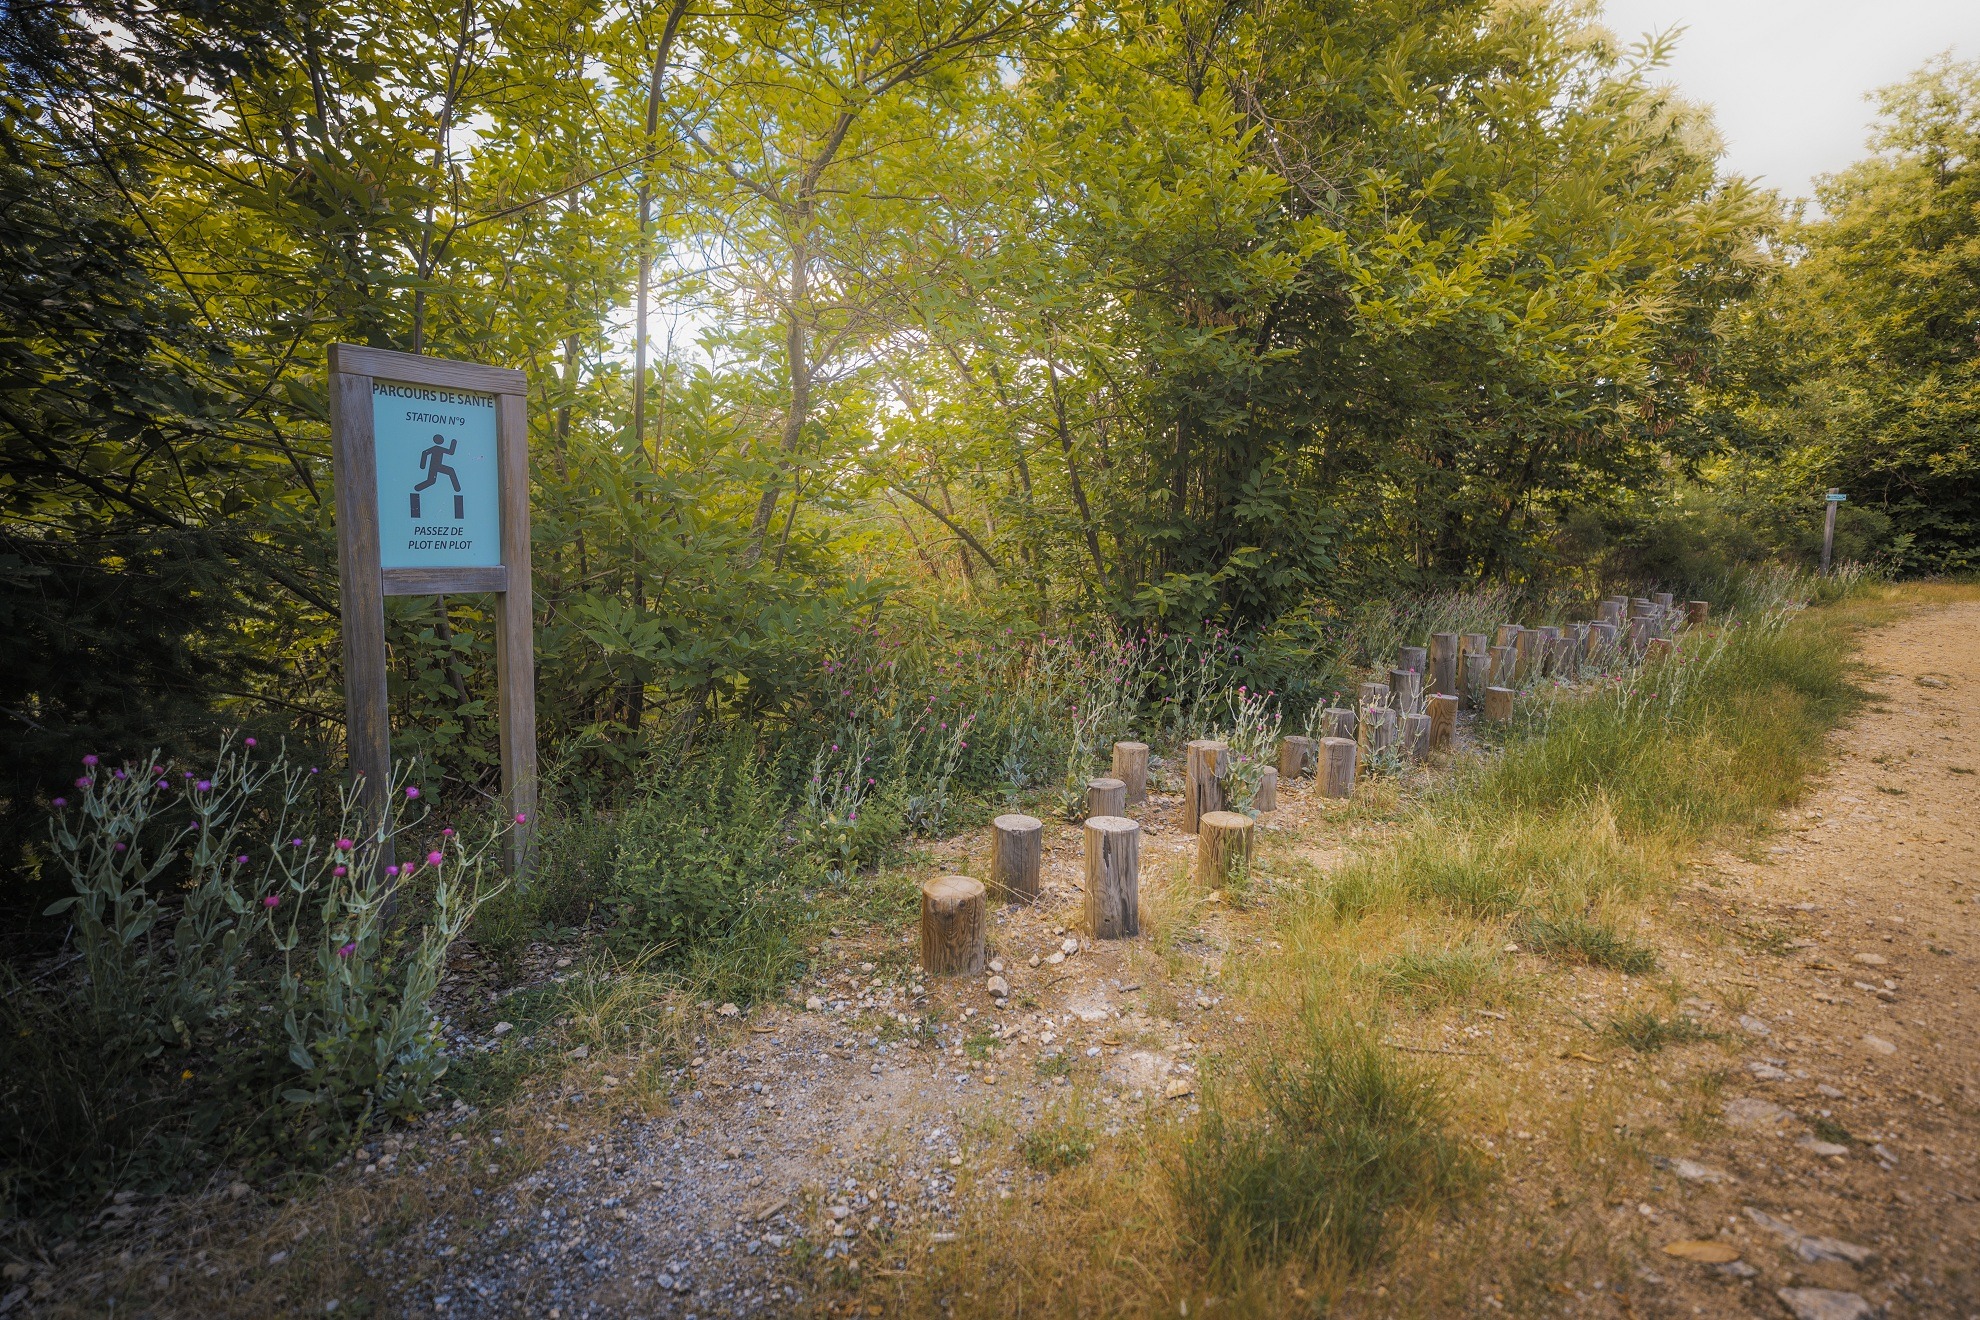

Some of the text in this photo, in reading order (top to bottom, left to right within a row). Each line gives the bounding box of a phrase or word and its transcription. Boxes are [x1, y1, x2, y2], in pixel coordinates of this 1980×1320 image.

[372, 382, 494, 408] PARCOURS DE SANTÉ
[405, 411, 465, 426] STATION N°9
[414, 526, 464, 536] PASSEZ DE
[408, 540, 473, 550] PLOT EN PLOT
